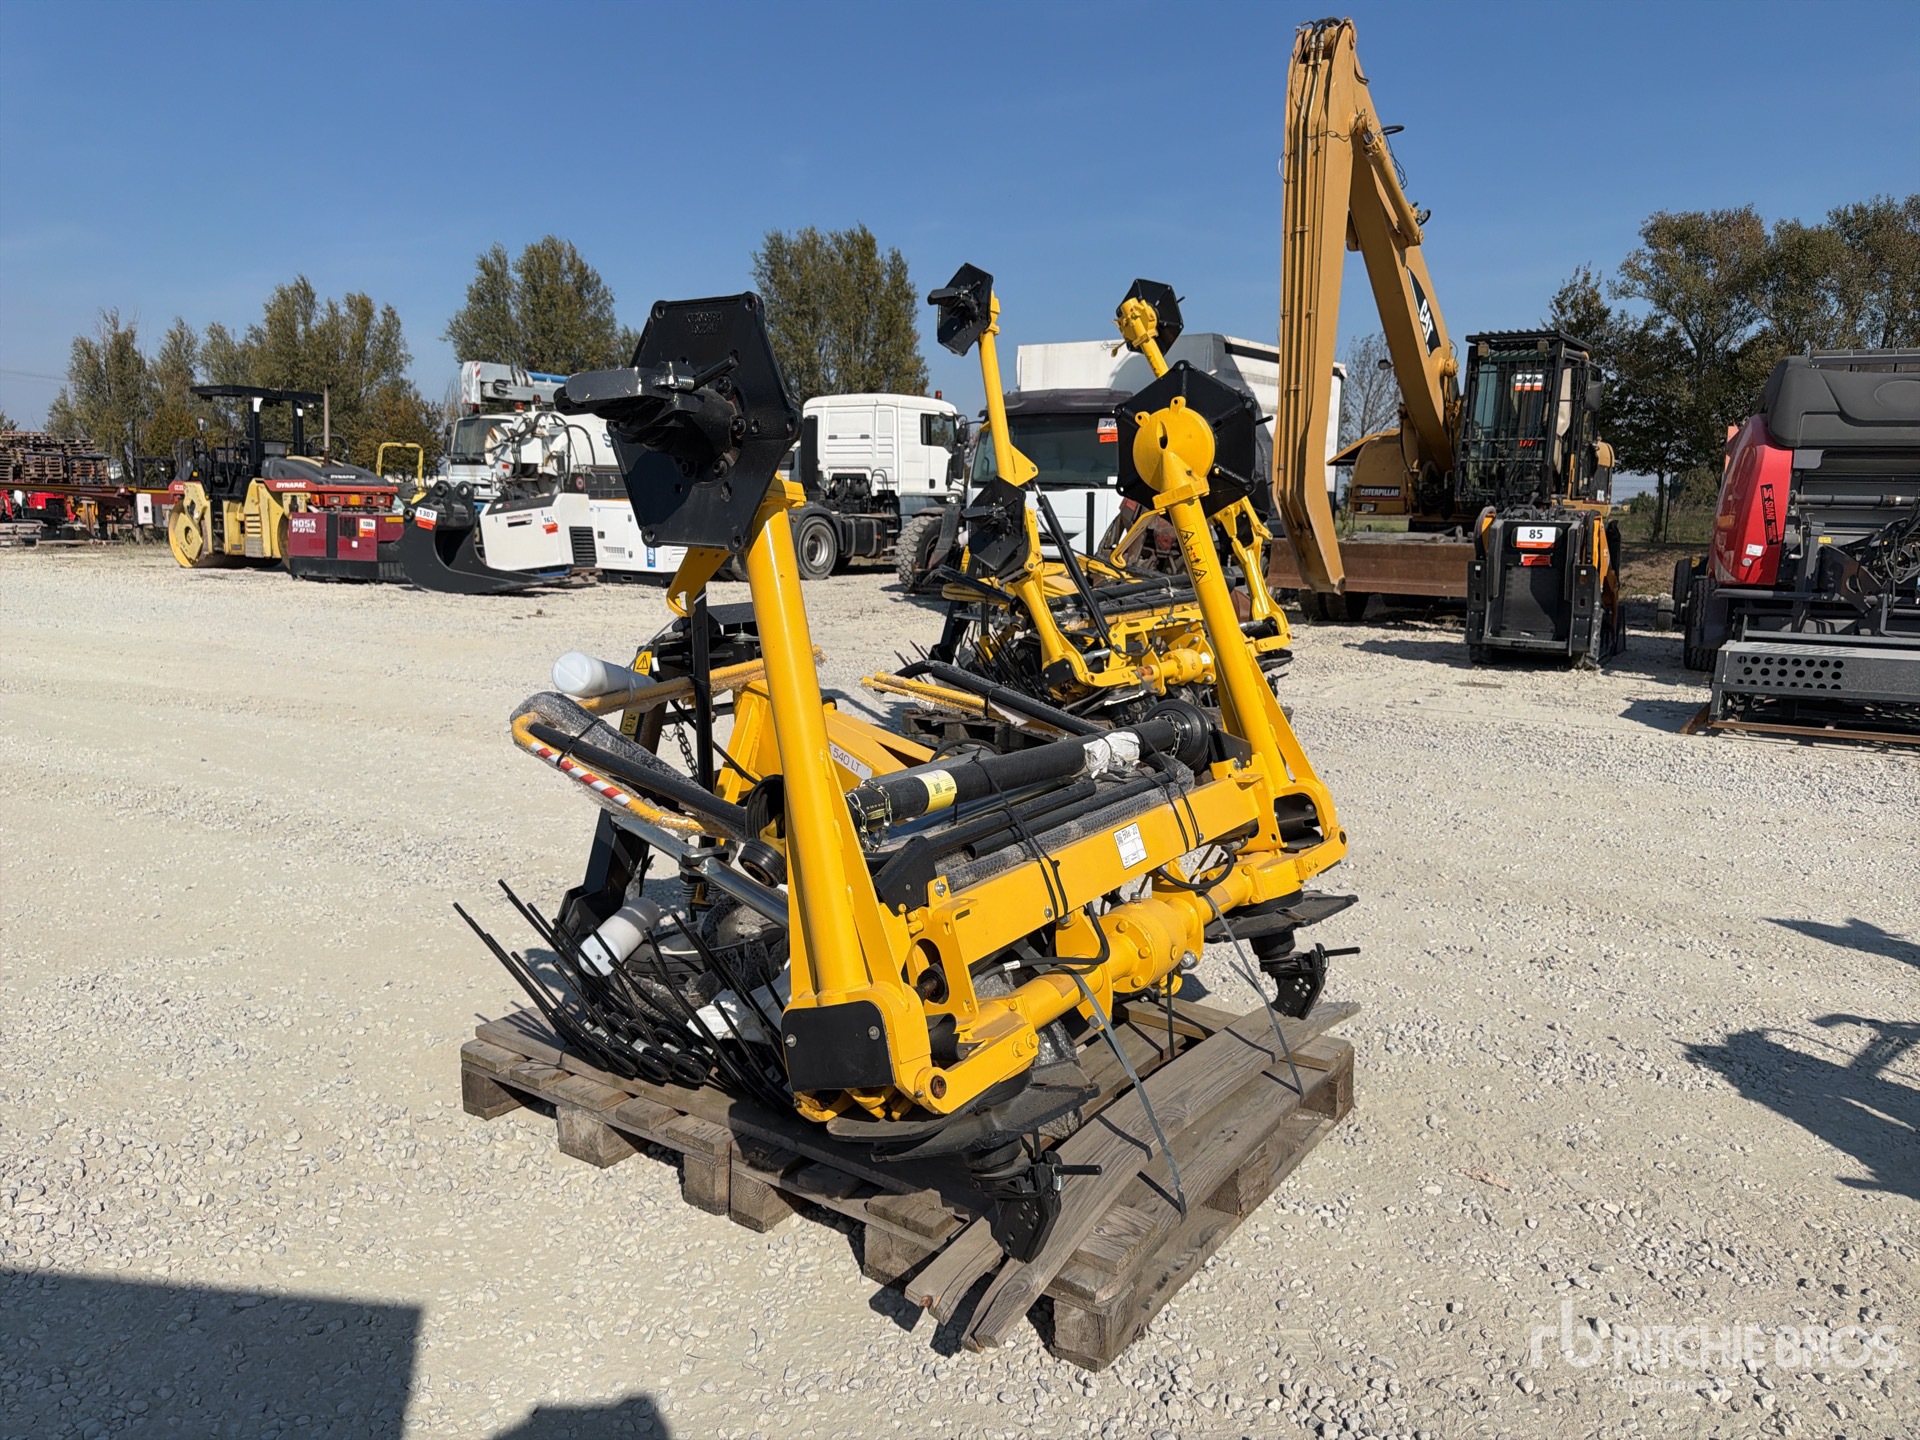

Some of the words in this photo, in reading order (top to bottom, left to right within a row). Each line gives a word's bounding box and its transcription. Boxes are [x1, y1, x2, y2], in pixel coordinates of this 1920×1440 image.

[1420, 299, 1433, 343] CAT
[276, 481, 306, 489] DYNAPAC
[1360, 488, 1399, 496] CATERPILLAR
[418, 509, 434, 519] 1307
[1529, 529, 1543, 539] 85
[833, 747, 850, 766] 540
[851, 760, 861, 772] LT
